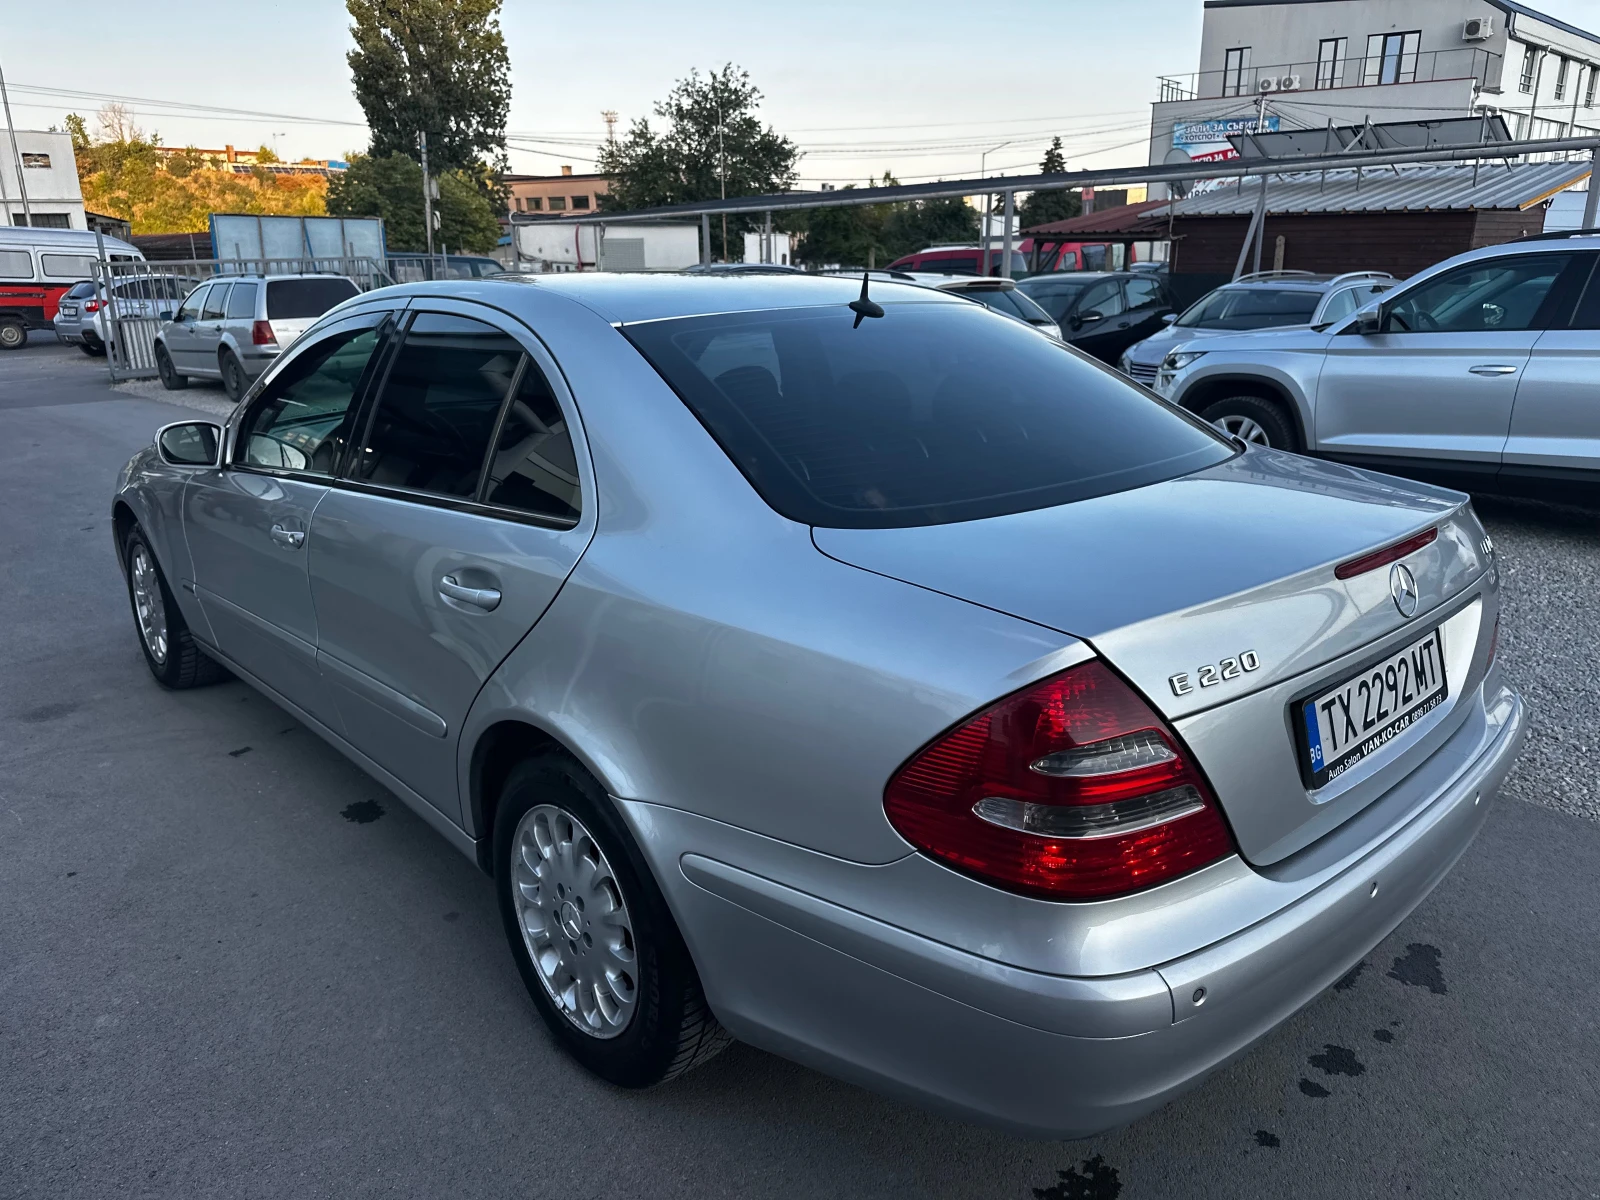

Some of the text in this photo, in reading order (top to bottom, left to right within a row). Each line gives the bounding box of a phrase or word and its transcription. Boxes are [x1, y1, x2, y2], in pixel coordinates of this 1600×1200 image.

[1185, 119, 1269, 134] ЗАЛИ ЗА СЪБИТЯ
[1213, 153, 1224, 161] ЗА
[1168, 649, 1261, 697] E 220
[1310, 744, 1322, 764] BG
[1328, 763, 1344, 781] Auto
[1344, 752, 1361, 770] Salon
[1361, 715, 1410, 756] VAN-KO-CAR
